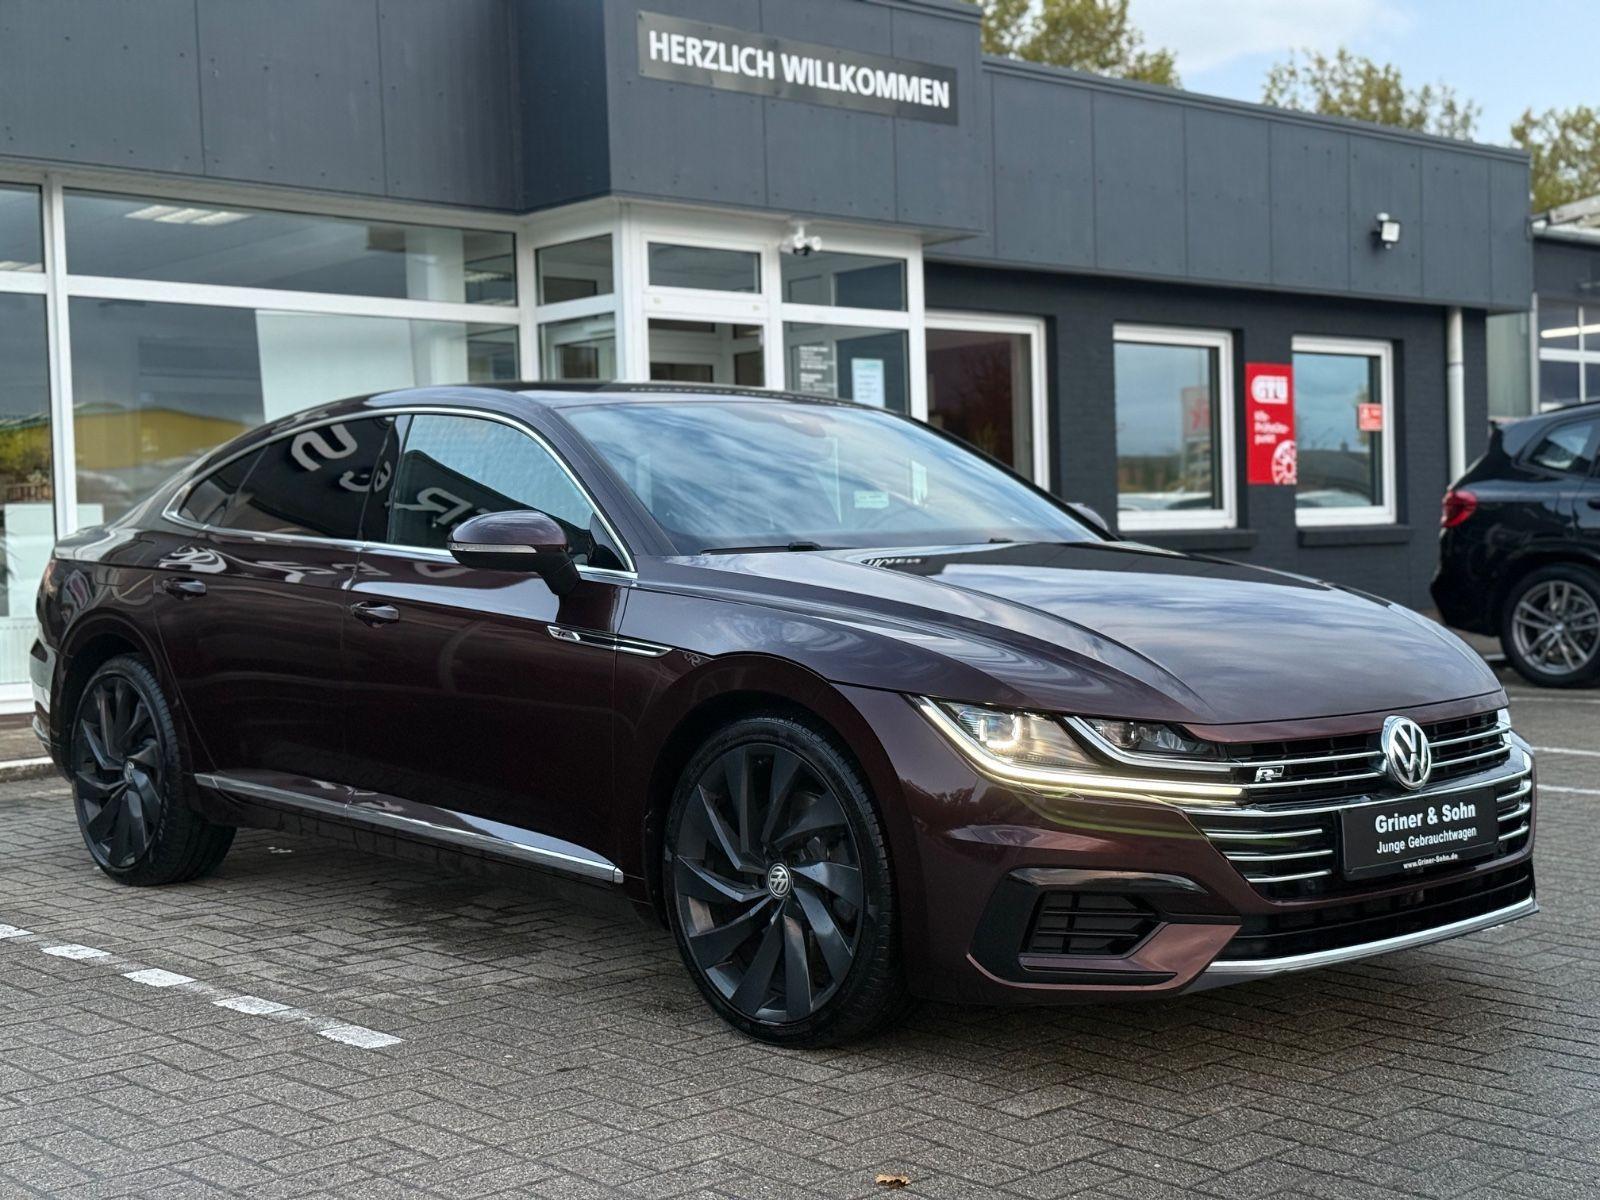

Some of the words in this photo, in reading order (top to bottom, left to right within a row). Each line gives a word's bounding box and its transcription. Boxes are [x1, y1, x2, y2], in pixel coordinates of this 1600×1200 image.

[649, 30, 775, 80] HERZLICH
[781, 53, 950, 109] WILLKOMMEN
[1375, 813, 1423, 834] Griner
[1427, 806, 1438, 825] &
[1441, 801, 1476, 822] Sohn
[1376, 841, 1406, 854] Junge
[1408, 827, 1478, 849] Gebrauchtwagen
[1402, 852, 1459, 870] www.Griner-Sohn.de
